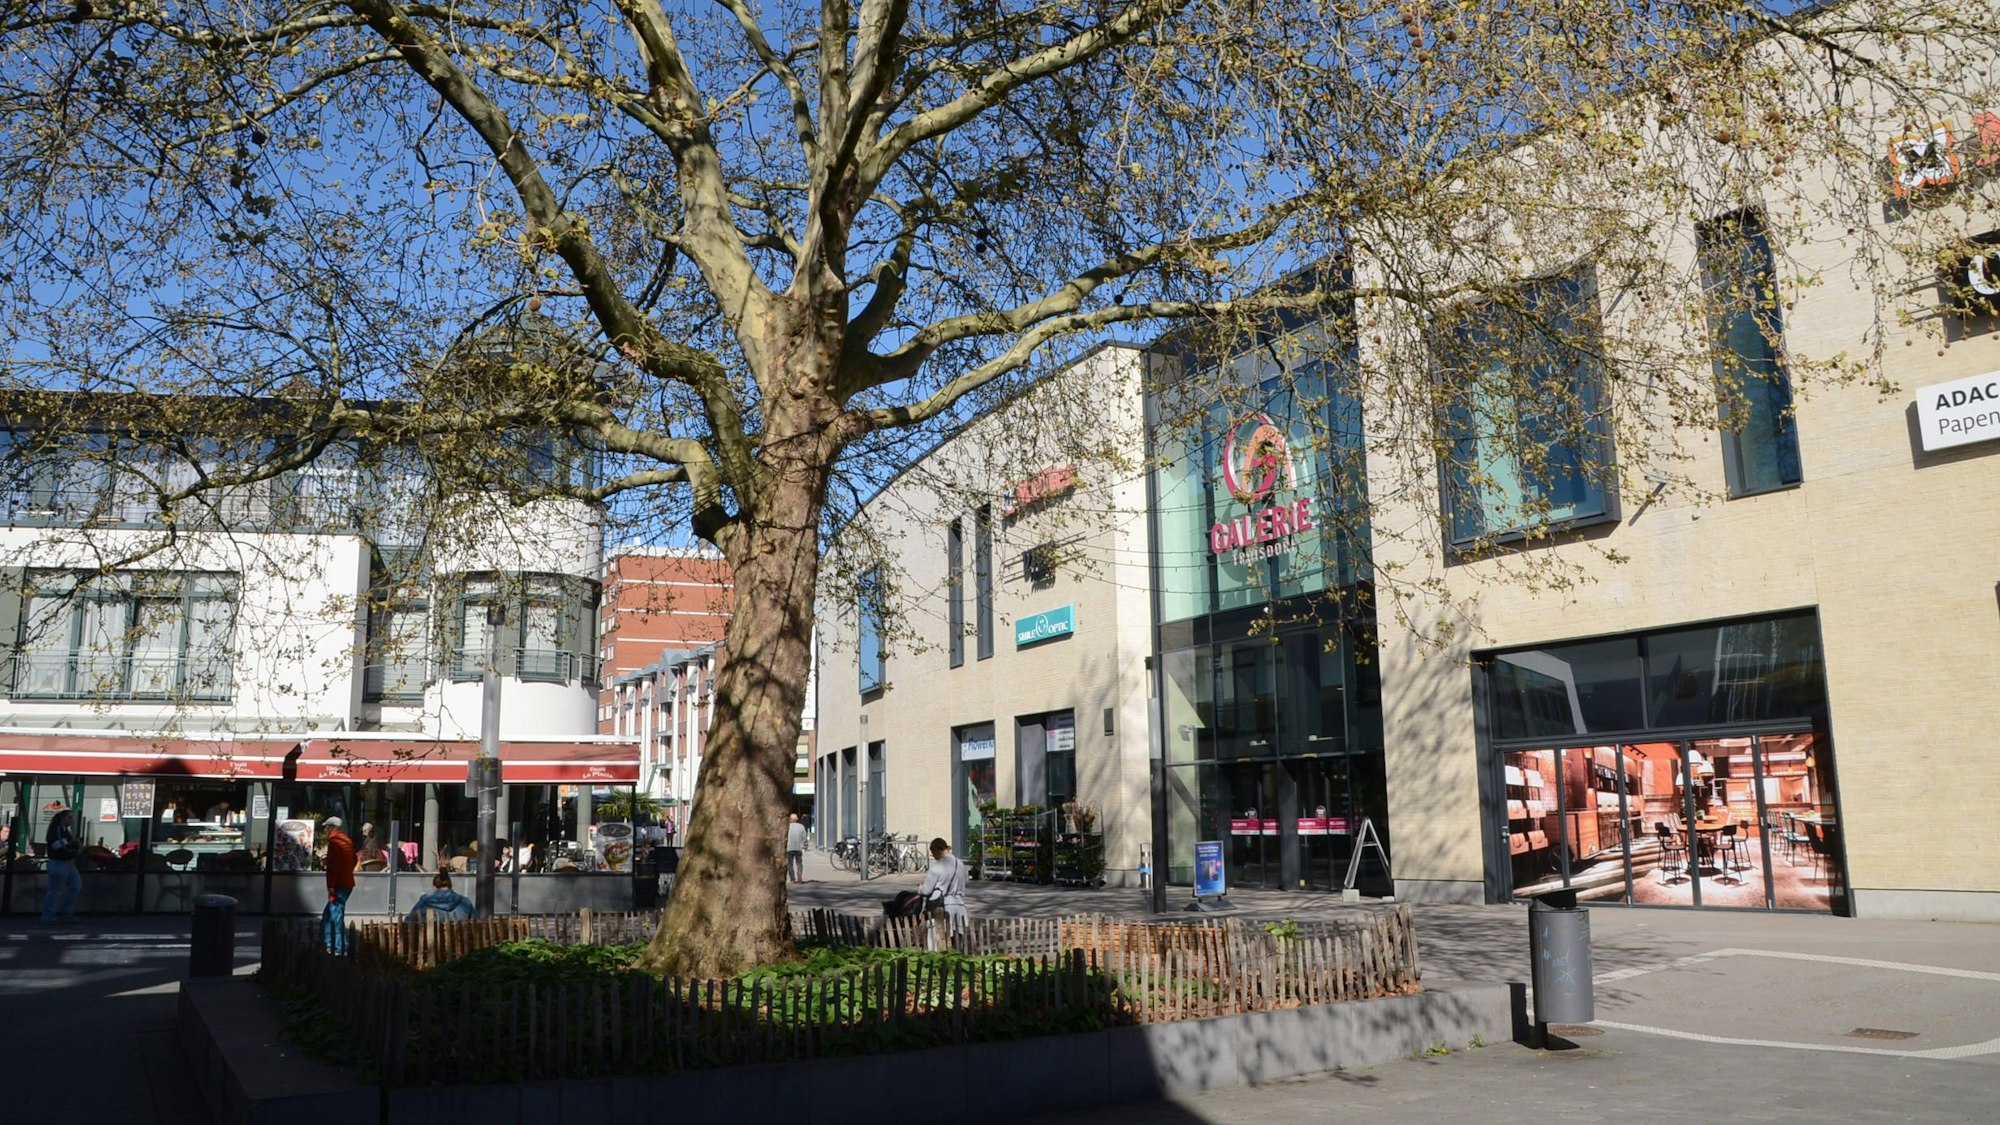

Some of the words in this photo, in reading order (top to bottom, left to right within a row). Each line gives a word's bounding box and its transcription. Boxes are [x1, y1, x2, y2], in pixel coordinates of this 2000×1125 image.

[1936, 382, 2000, 411] ADAC
[1938, 410, 2000, 435] Papen
[1211, 497, 1315, 554] GALERIE
[1017, 629, 1038, 643] SMILE
[1047, 620, 1070, 635] OPTIC
